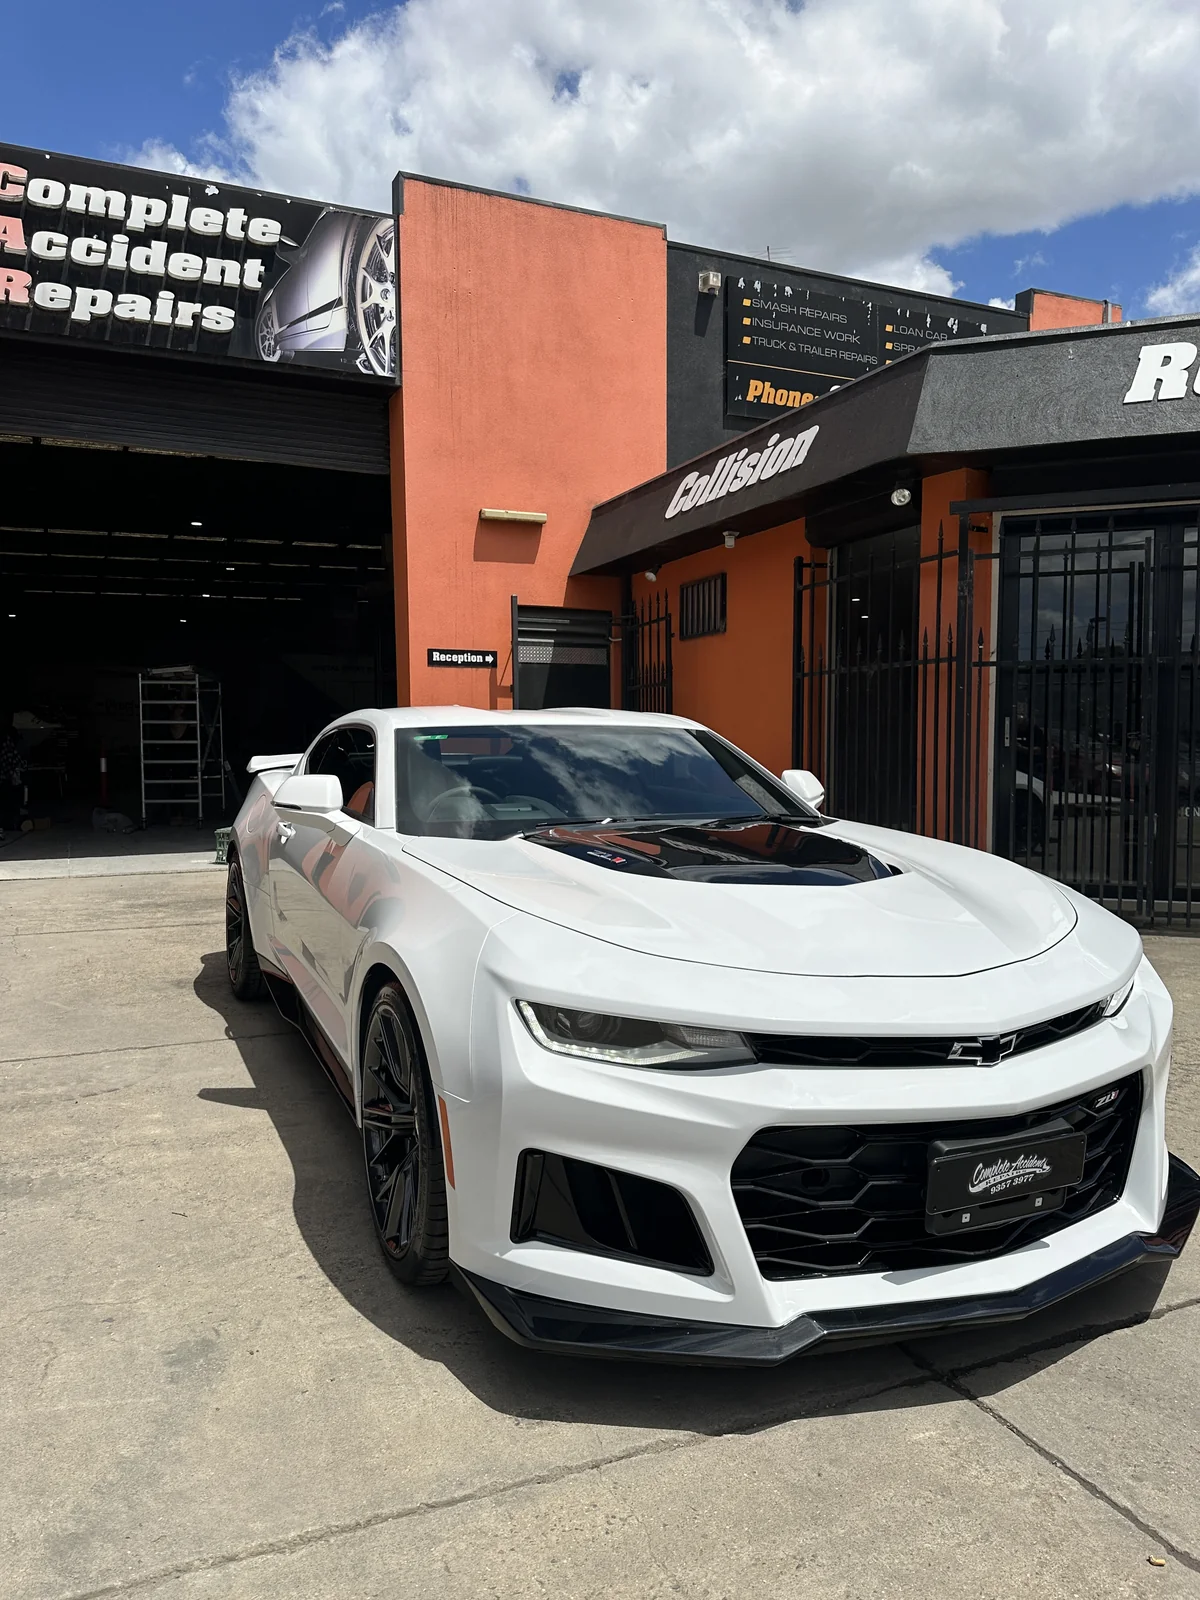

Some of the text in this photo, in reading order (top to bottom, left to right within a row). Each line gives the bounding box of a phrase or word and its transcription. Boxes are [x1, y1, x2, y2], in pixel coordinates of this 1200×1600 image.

[0, 162, 282, 246] Complete
[0, 215, 266, 291] Accident
[0, 267, 237, 333] Repairs
[751, 298, 848, 324] SMASH REPAIRS
[751, 317, 861, 345] INSURANCE WORK
[893, 324, 948, 341] LOAN CAR
[752, 335, 878, 365] TRUCK & TRAILER REPAIRS
[893, 342, 920, 353] SPR
[1123, 341, 1200, 405] R
[664, 424, 820, 520] Collision
[432, 651, 484, 665] Reception
[973, 1154, 1048, 1185] Complete Accident
[990, 1173, 1035, 1195] 9357 3977
